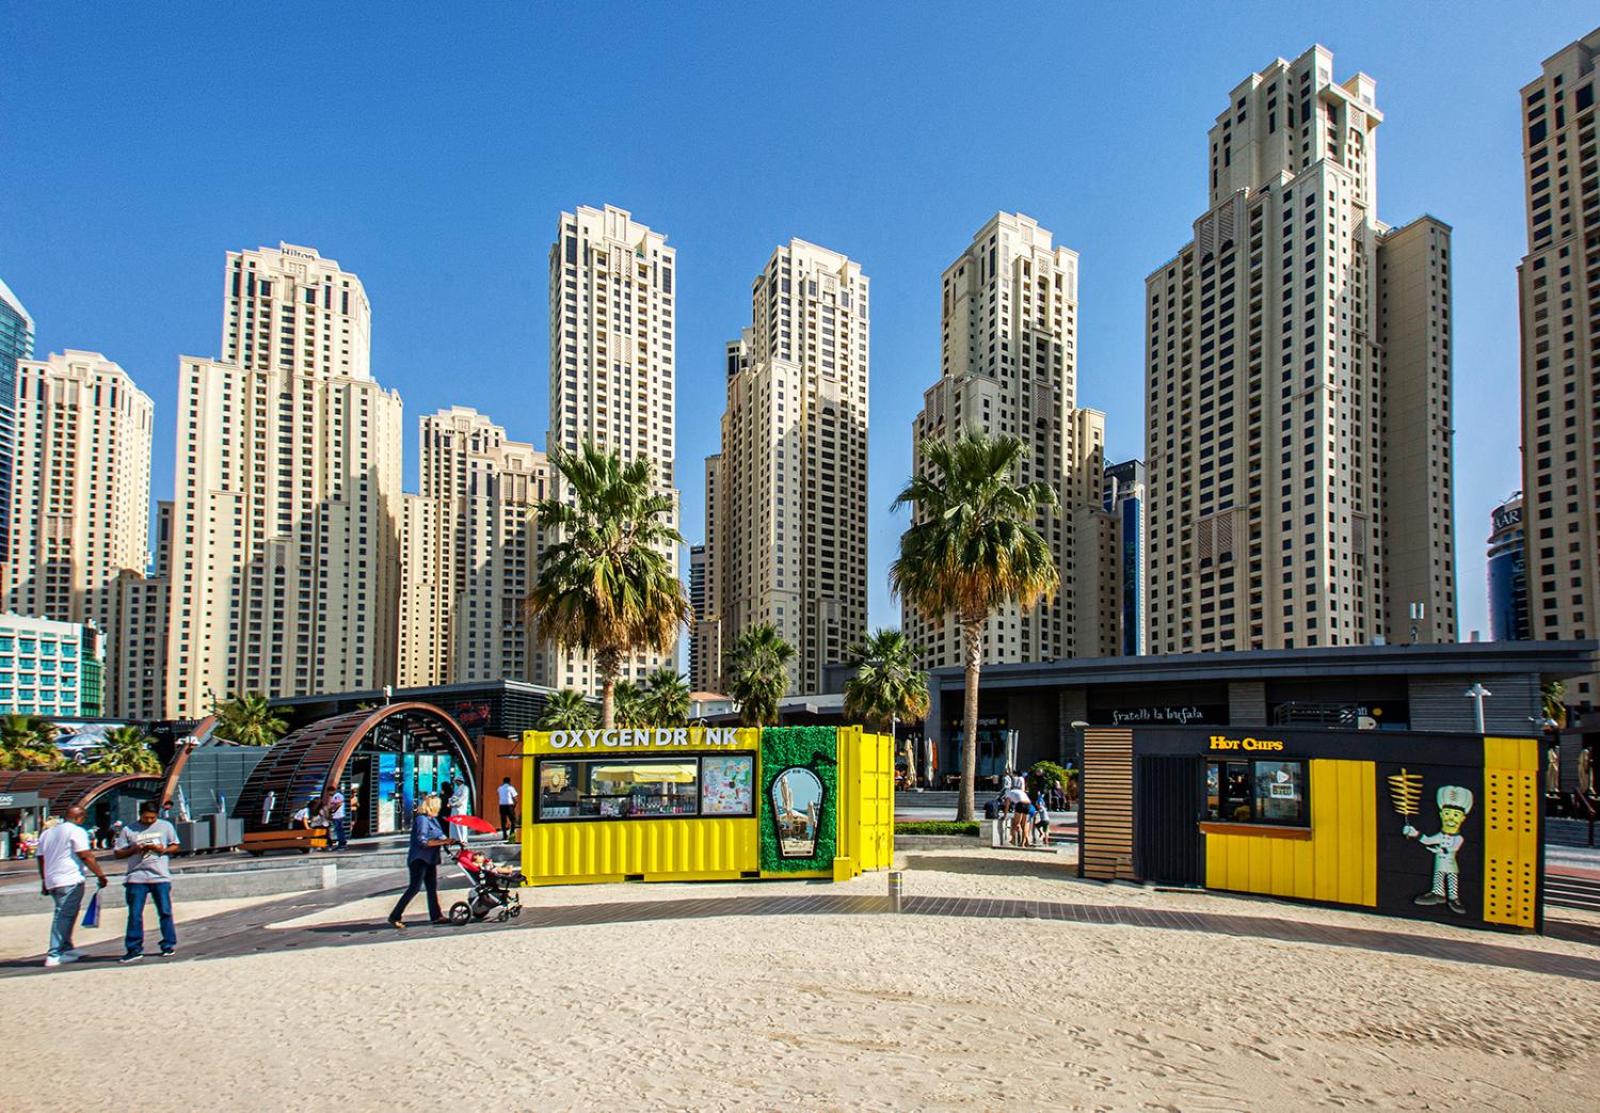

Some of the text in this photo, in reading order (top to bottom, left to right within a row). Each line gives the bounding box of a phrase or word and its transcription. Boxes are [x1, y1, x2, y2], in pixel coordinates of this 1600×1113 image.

[282, 248, 315, 261] Hilton
[1153, 708, 1164, 720] la
[1166, 706, 1204, 724] bufala
[550, 728, 650, 748] OXYGEN
